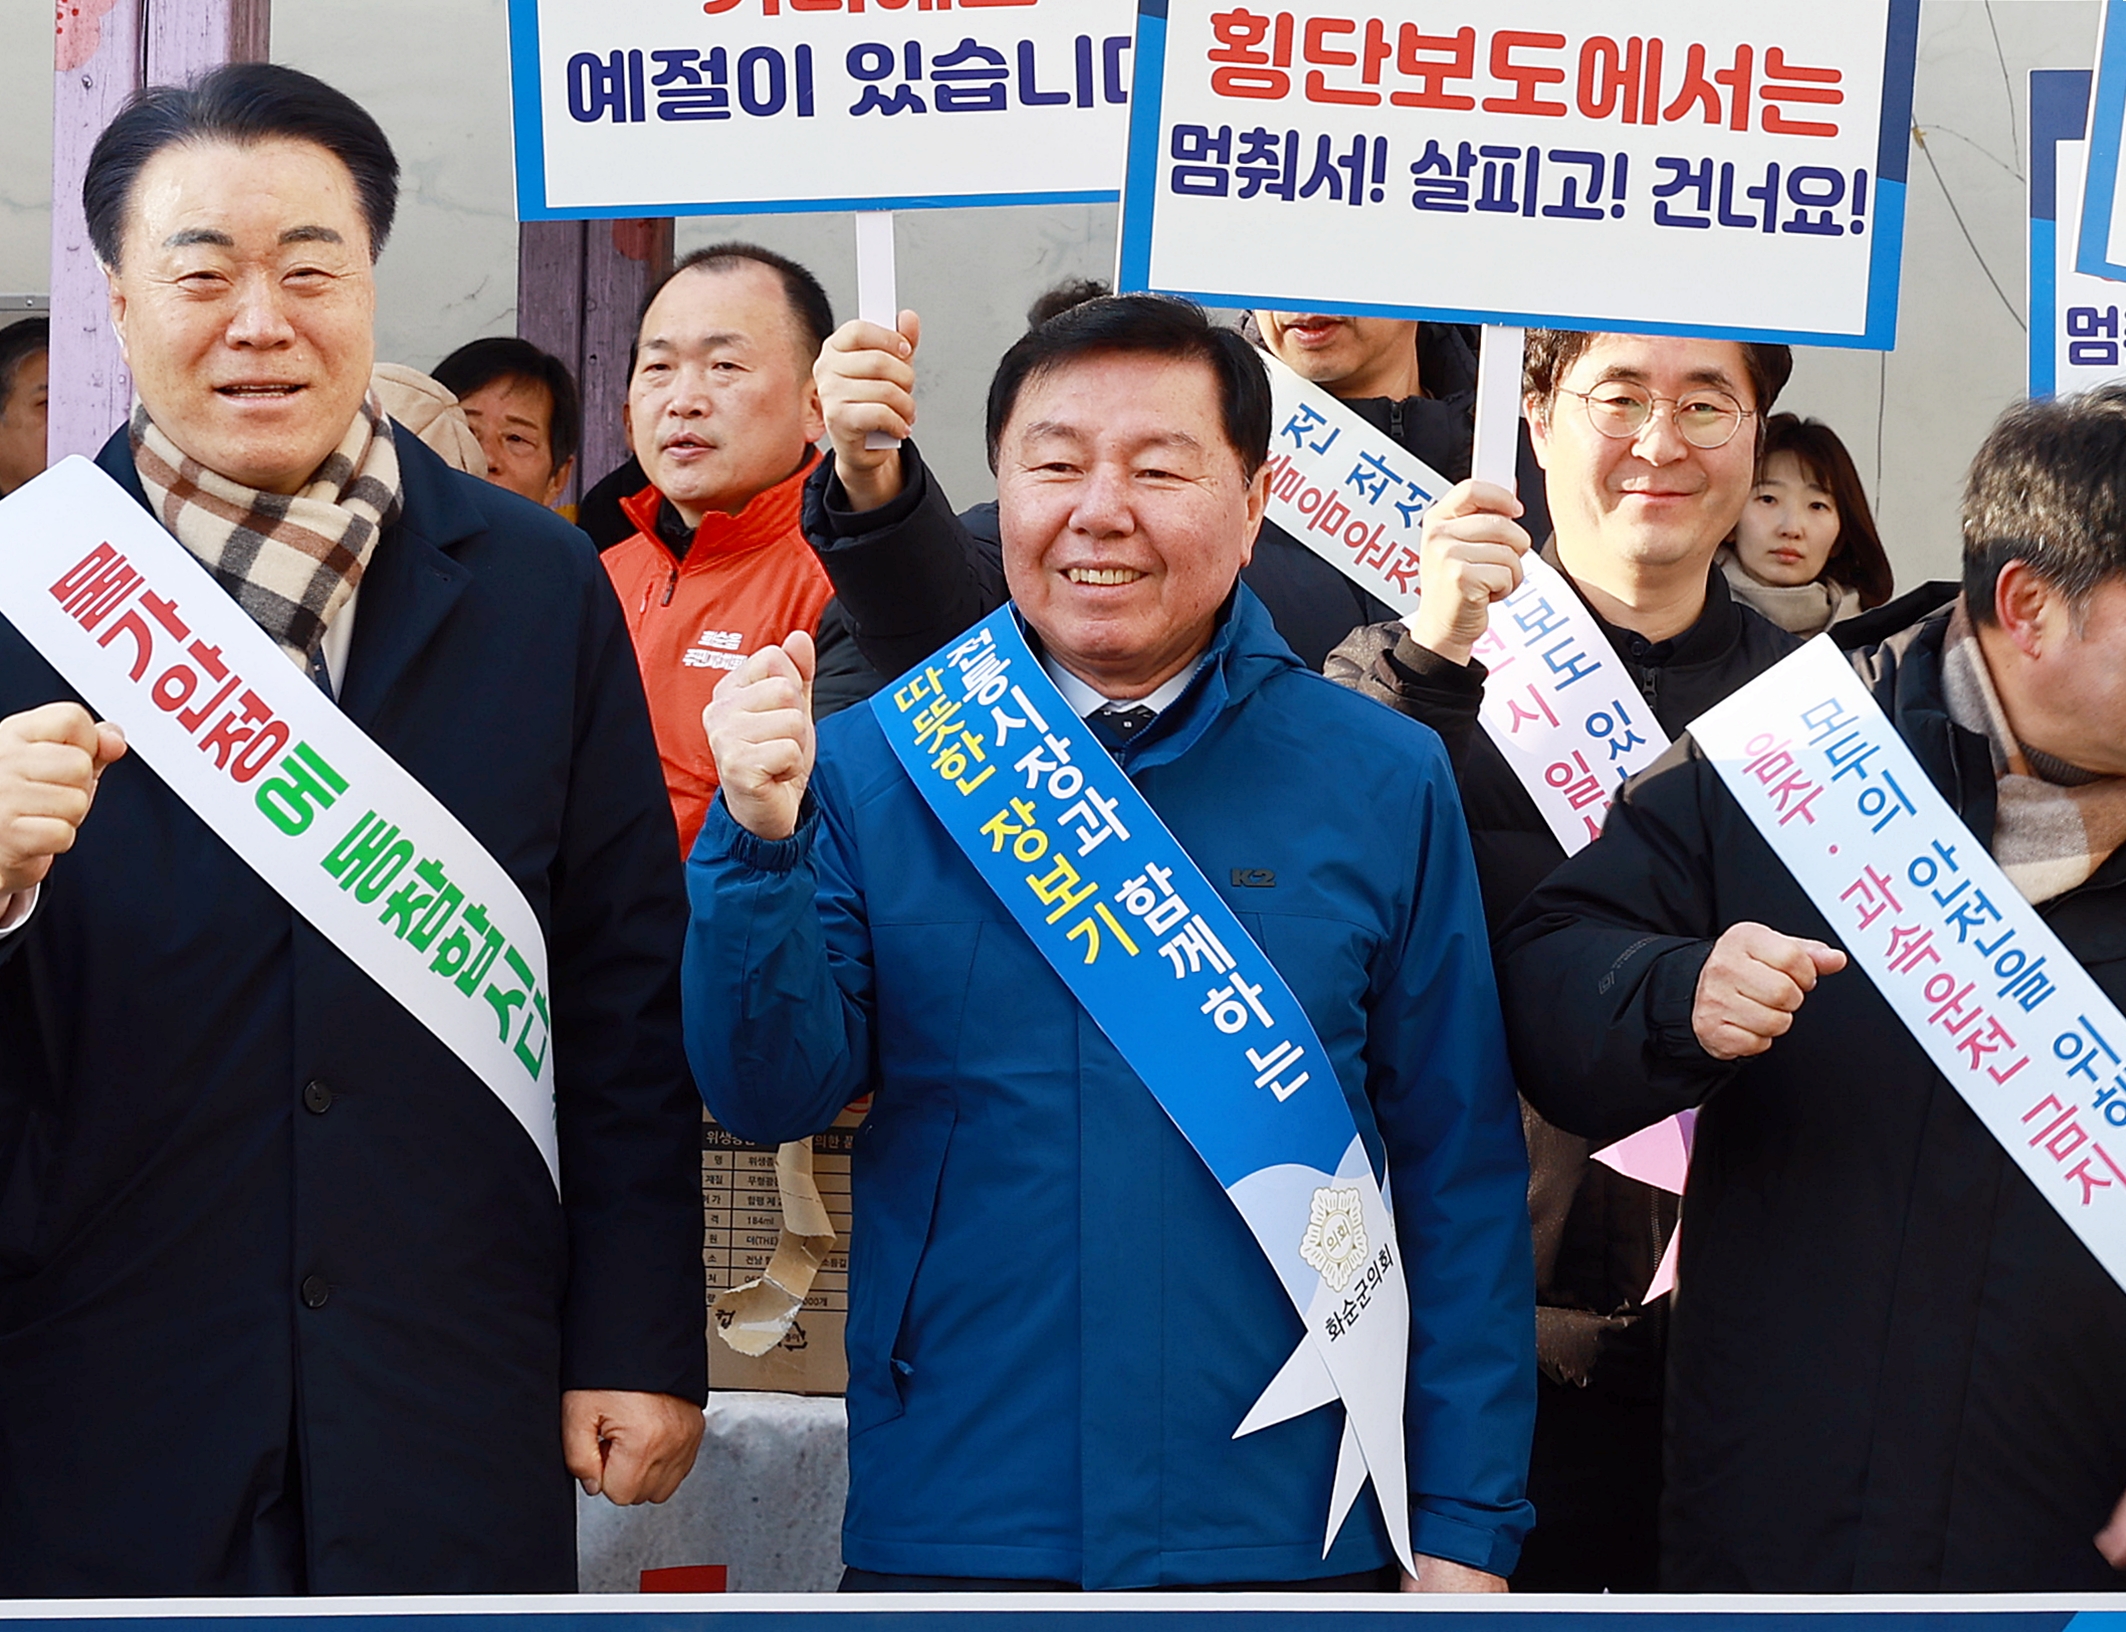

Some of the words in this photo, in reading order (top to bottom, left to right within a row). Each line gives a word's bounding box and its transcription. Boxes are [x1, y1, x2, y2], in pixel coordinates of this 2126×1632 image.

[566, 43, 815, 124] 예절이
[1207, 6, 1845, 138] 횡단보도에서는
[1169, 122, 1388, 206] 멈춰서!
[1410, 138, 1628, 220] 살피고!
[1653, 156, 1868, 237] 건너요!
[2066, 304, 2126, 367] 멈
[48, 540, 351, 838] 물가안정에
[893, 666, 998, 797] 따뜻한
[979, 796, 1141, 965] 장보기
[1544, 749, 1614, 843] 일
[946, 627, 1132, 858] 전통시장과
[1114, 860, 1310, 1103] 함께하는
[1231, 868, 1276, 887] K2
[1799, 697, 1917, 835] 모두의
[1907, 839, 2057, 1014] 안전을
[1742, 731, 1825, 827] 음주
[1839, 864, 2031, 1086] 과속운전
[2021, 1093, 2126, 1207] 금지
[1324, 1242, 1394, 1343] 화순군의회
[1326, 1218, 1352, 1253] 의회
